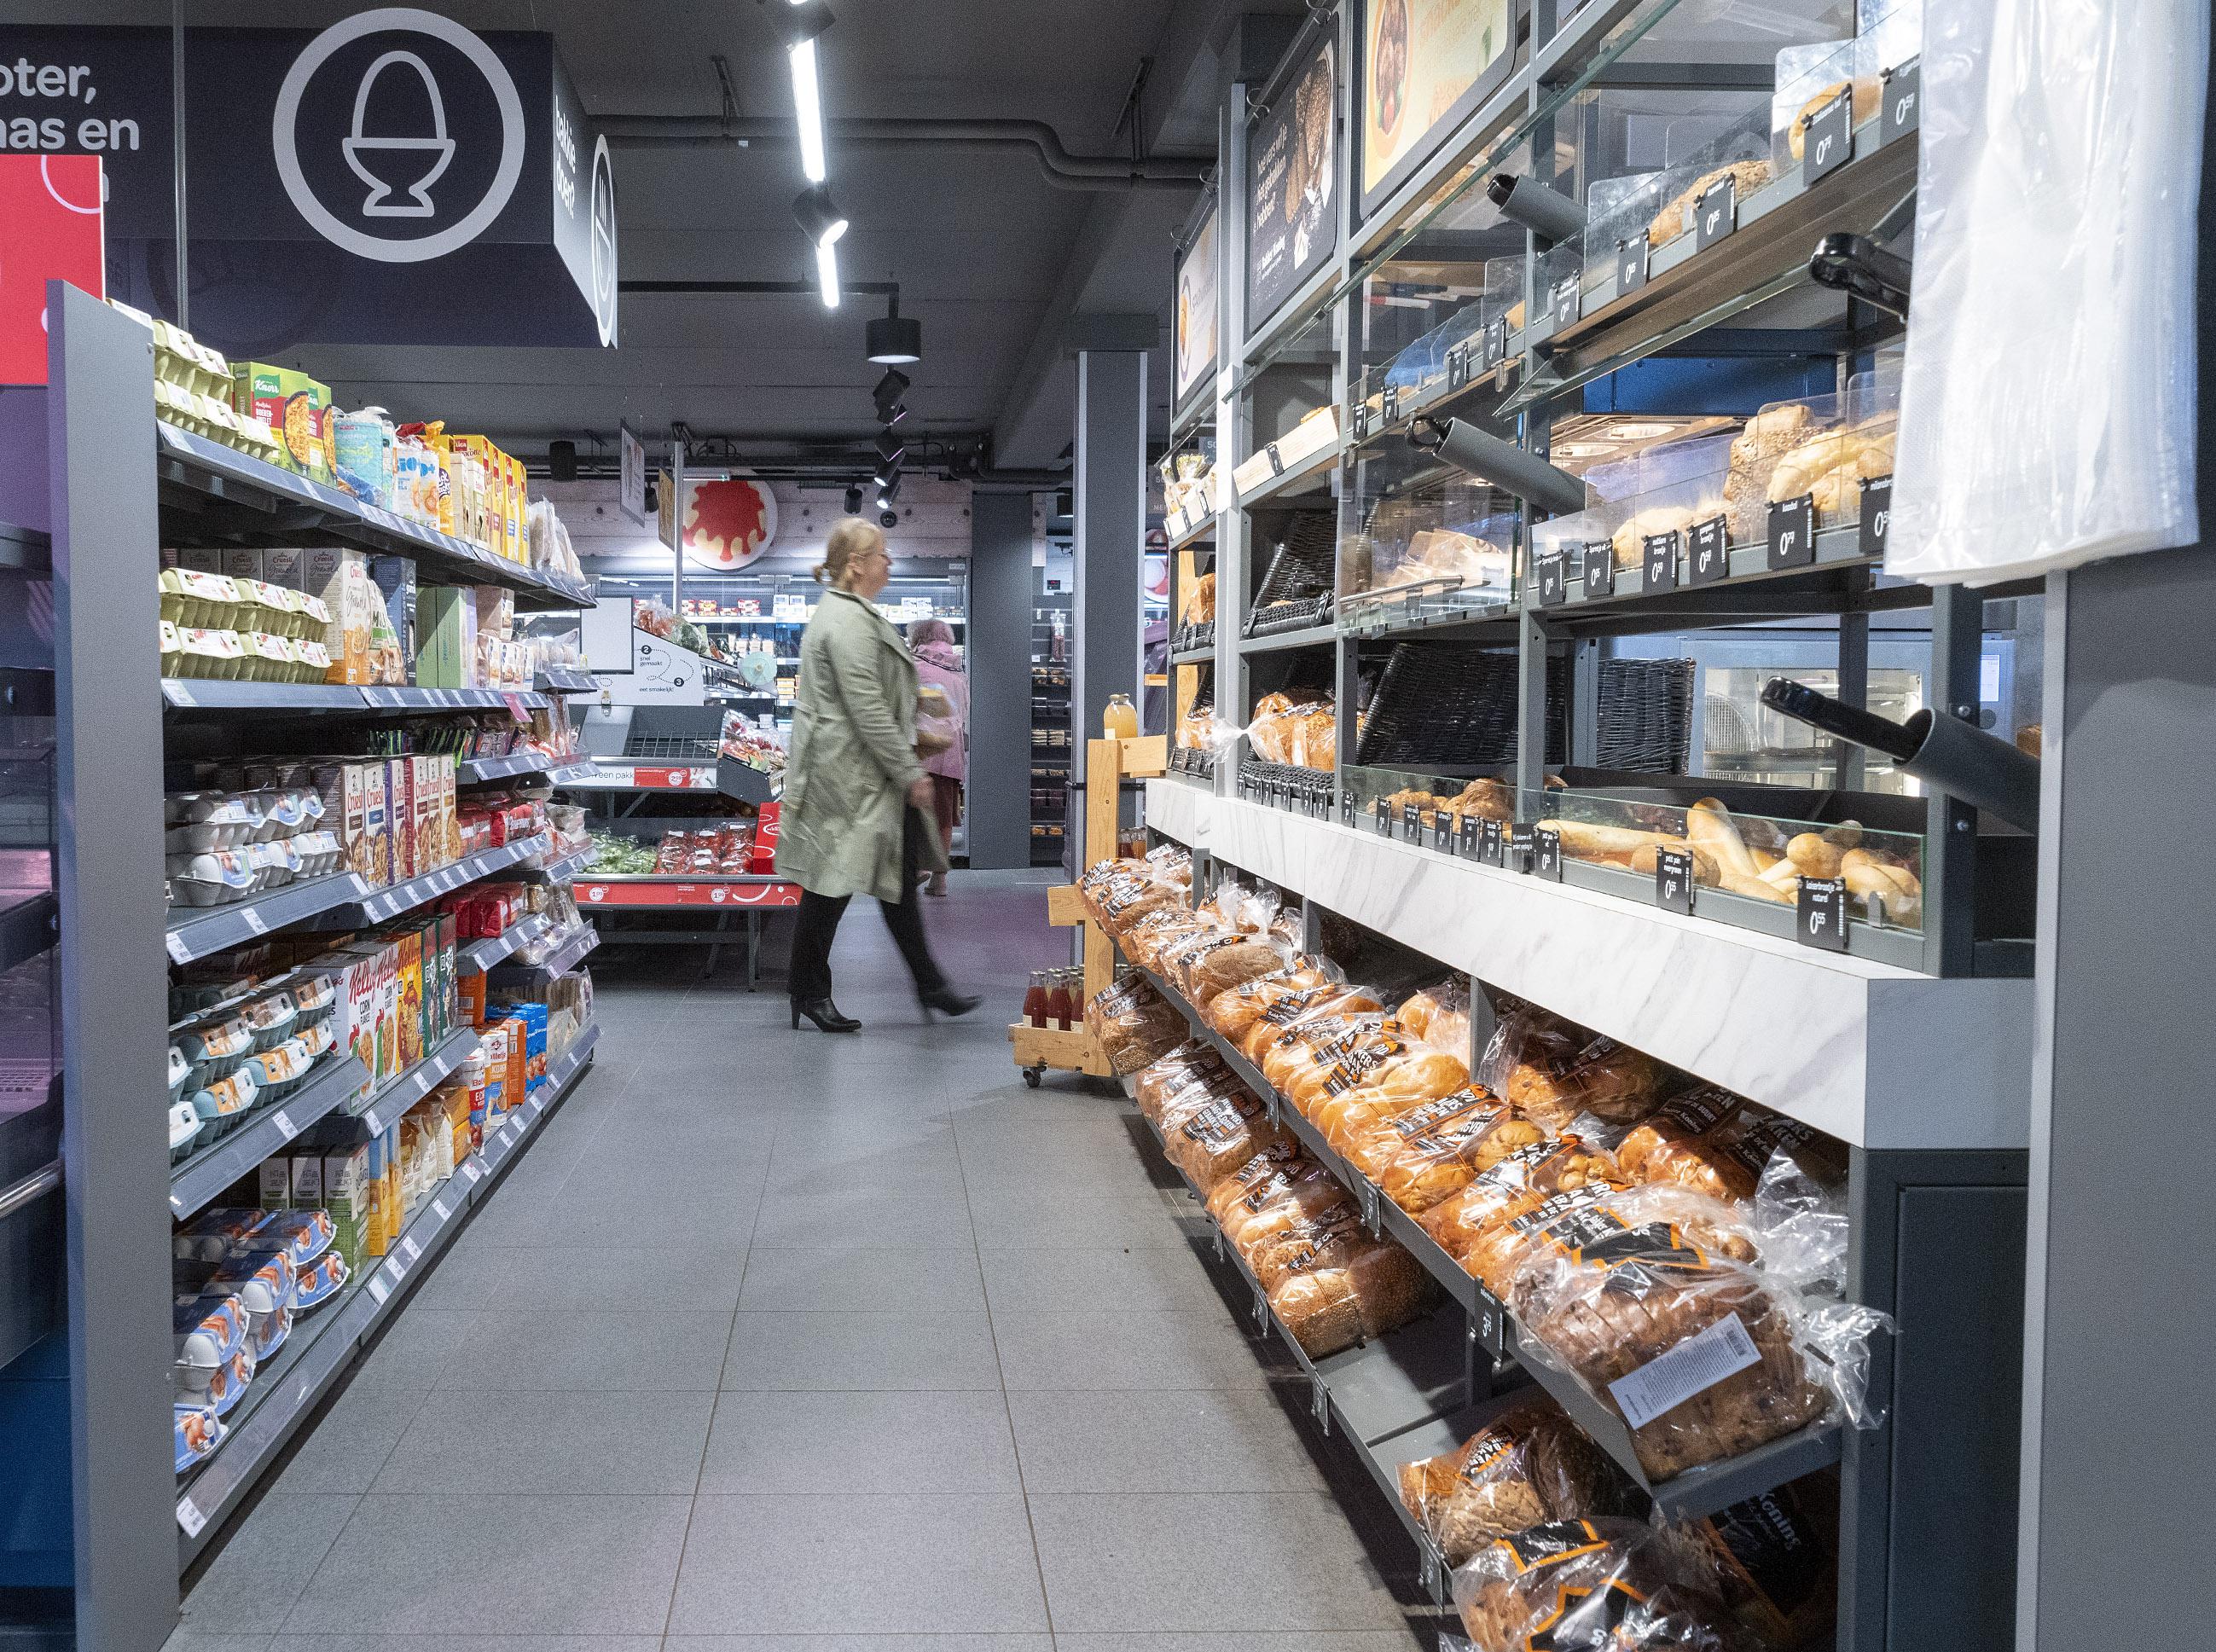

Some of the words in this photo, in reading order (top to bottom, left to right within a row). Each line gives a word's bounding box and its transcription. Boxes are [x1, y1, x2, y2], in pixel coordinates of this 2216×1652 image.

[0, 118, 66, 149] as
[78, 119, 140, 150] en
[255, 379, 280, 394] Knorr
